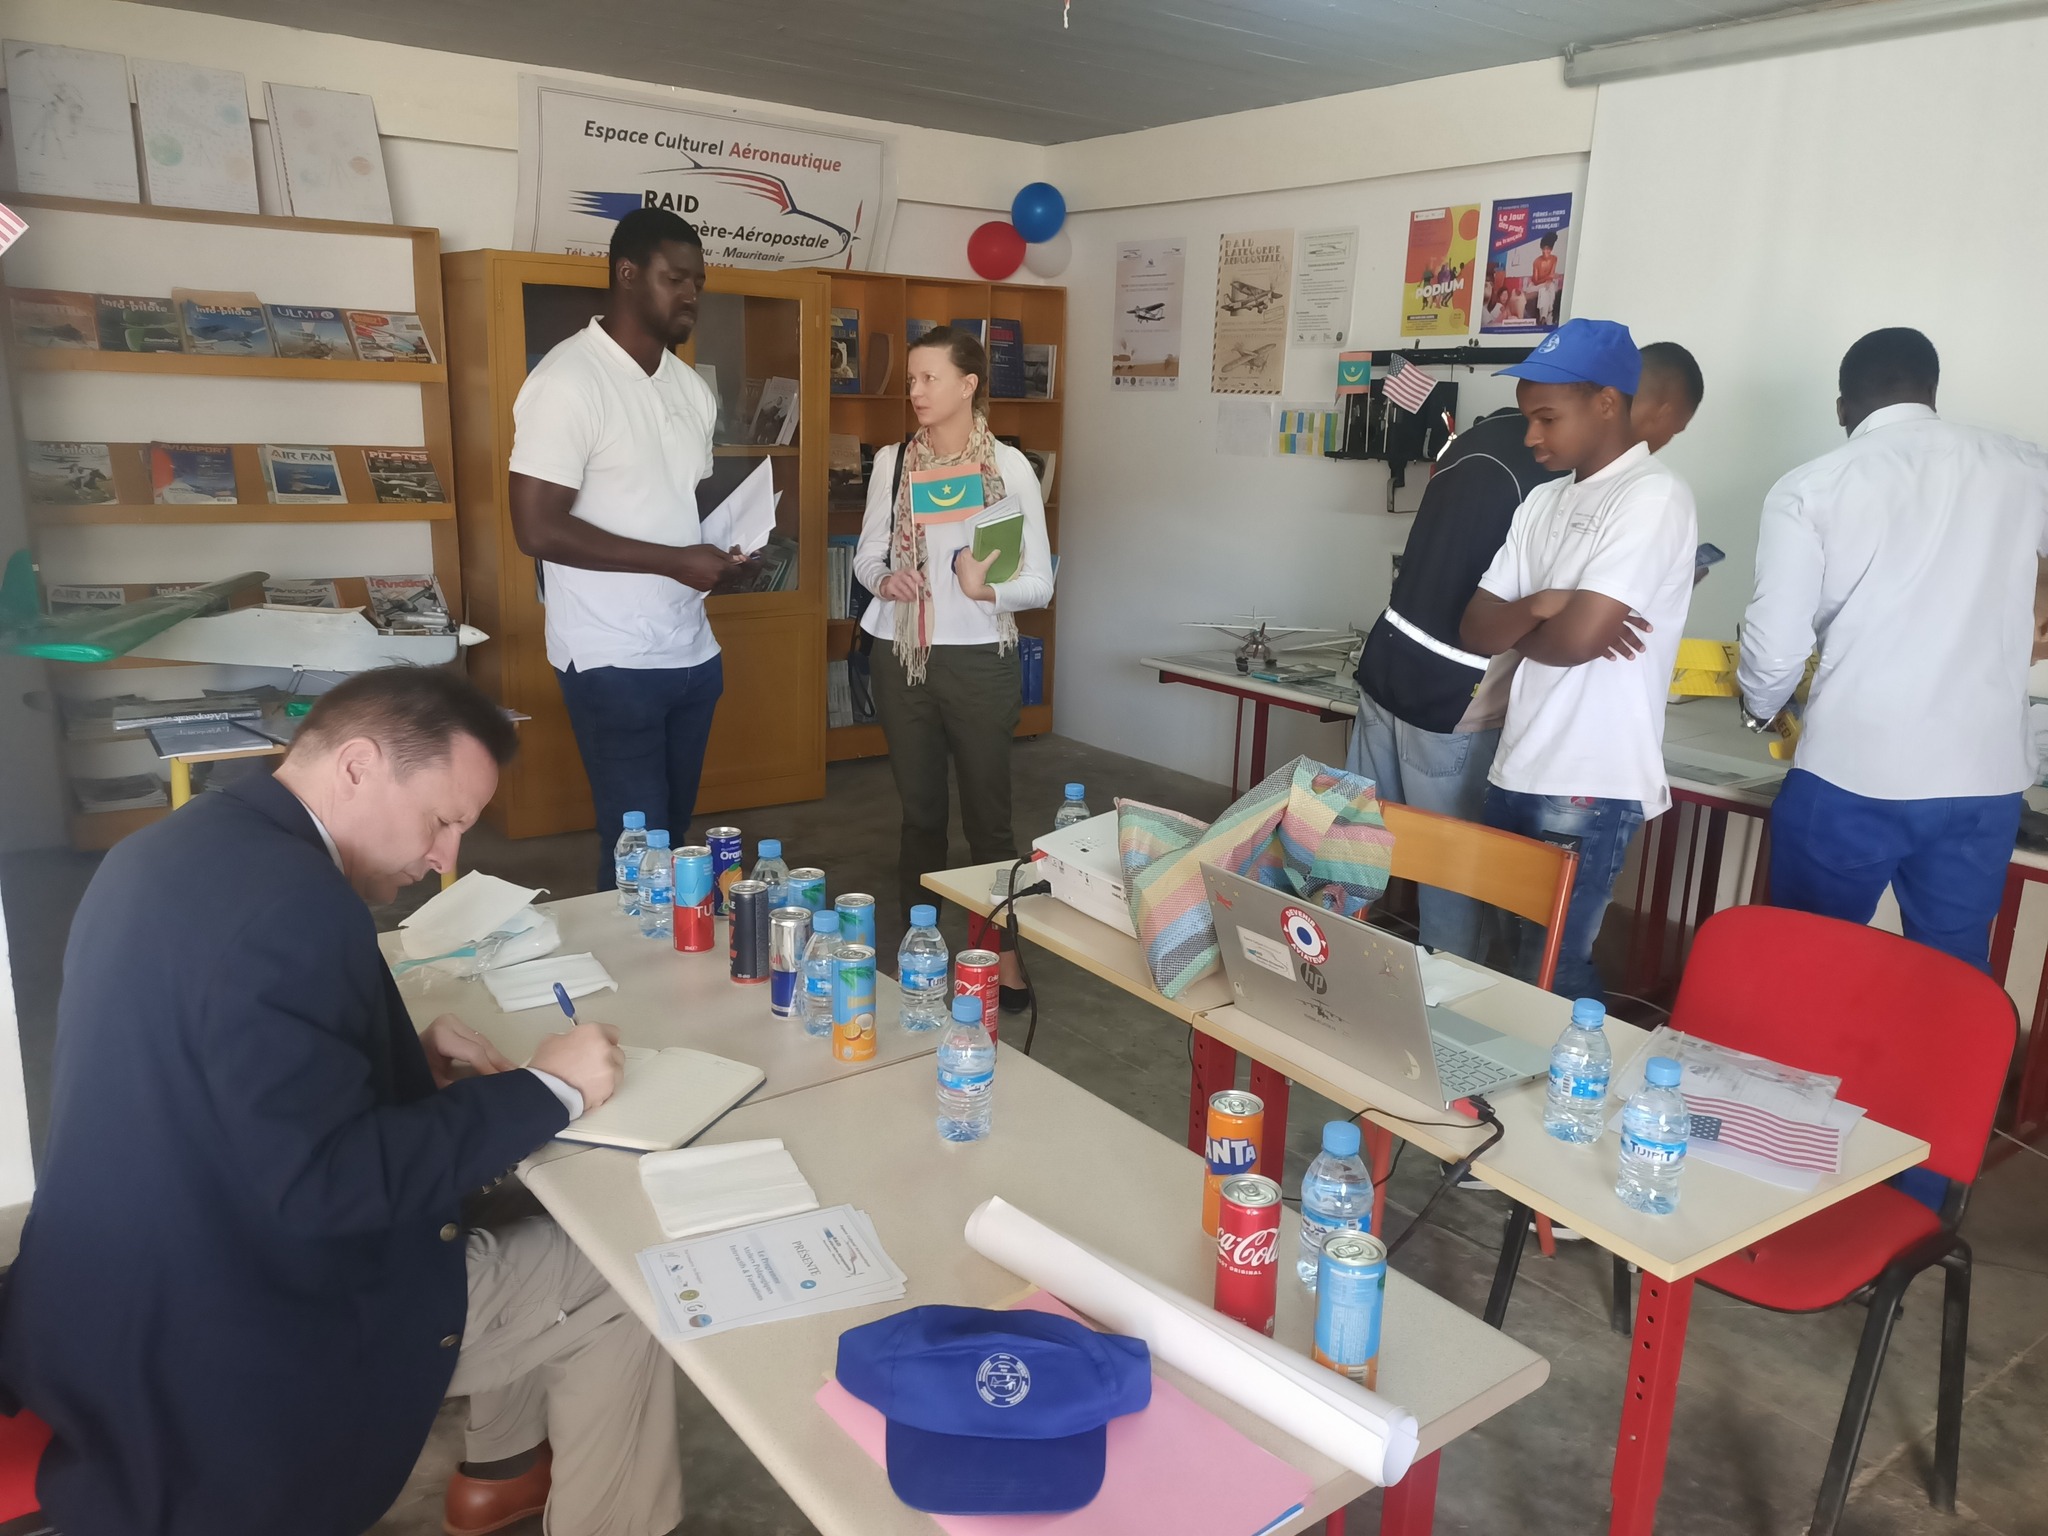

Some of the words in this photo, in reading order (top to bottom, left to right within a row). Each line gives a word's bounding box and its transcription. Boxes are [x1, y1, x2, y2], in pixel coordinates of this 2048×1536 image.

[584, 120, 648, 145] Espace
[654, 131, 724, 157] Culturel
[728, 142, 842, 173] Aéronautique
[644, 189, 699, 213] RAID
[723, 247, 784, 263] Mauritanie
[1415, 278, 1464, 299] PODIUM
[161, 443, 228, 454] AVIASPORT
[271, 450, 296, 460] AIR
[301, 453, 332, 461] FAN
[51, 588, 81, 599] AIR
[86, 590, 121, 600] FAN
[720, 850, 742, 860] Oran
[1285, 908, 1316, 927] DEVENIR
[1290, 943, 1326, 964] AVIATEUR
[1305, 962, 1324, 993] hp
[1206, 1135, 1256, 1166] ANTA
[1630, 1140, 1675, 1162] TIJIRIT
[791, 1240, 821, 1276] PRÉSENTE
[1229, 1265, 1262, 1276] ORIGINAL
